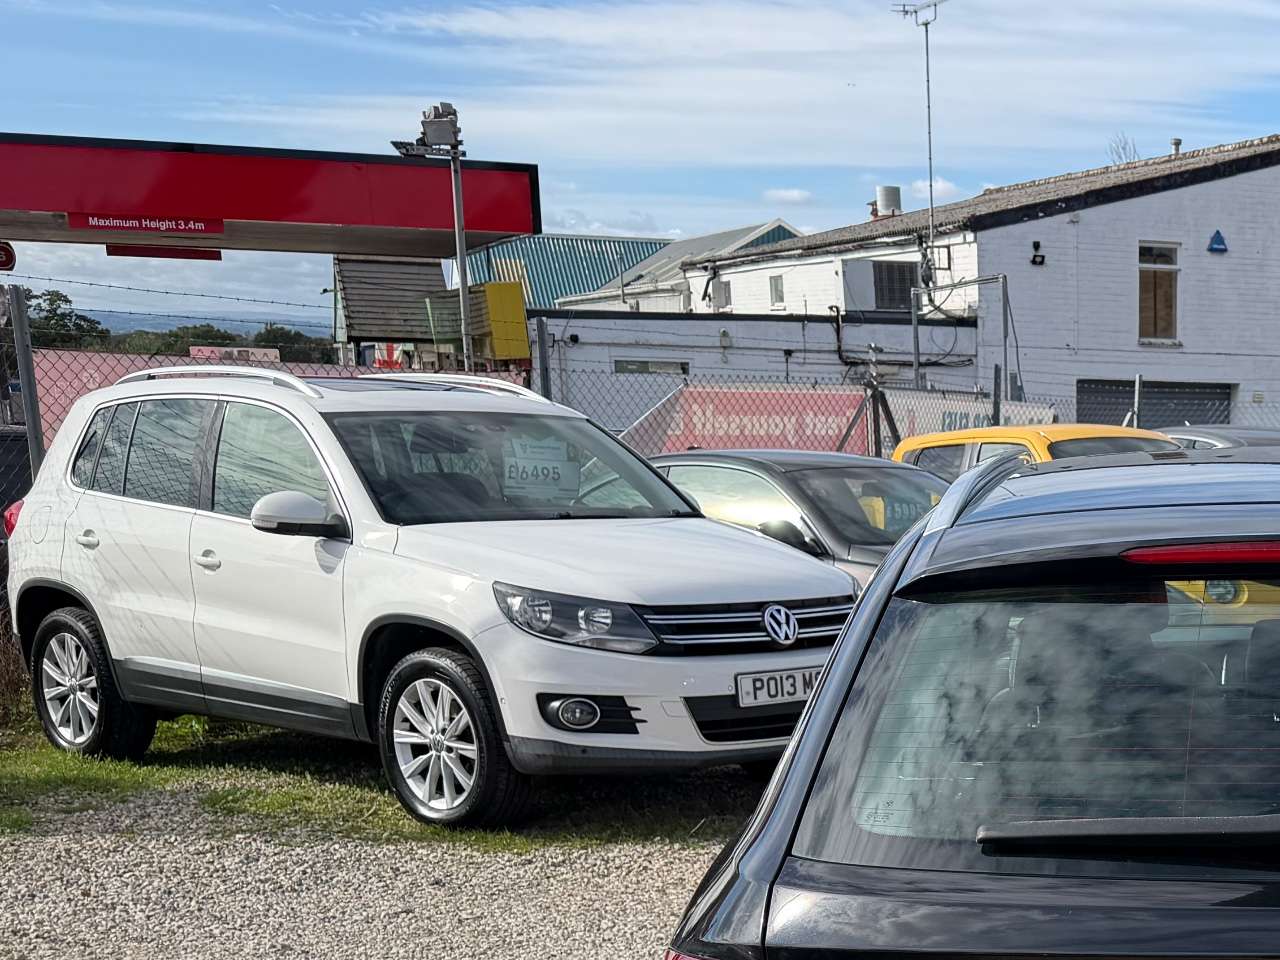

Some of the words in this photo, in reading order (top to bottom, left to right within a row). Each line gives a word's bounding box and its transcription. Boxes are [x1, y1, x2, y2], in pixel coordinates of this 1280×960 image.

[88, 217, 139, 228] Maximum
[142, 218, 176, 231] Height
[177, 220, 205, 230] 3.4m
[508, 463, 561, 481] £6495
[751, 674, 797, 701] PO13
